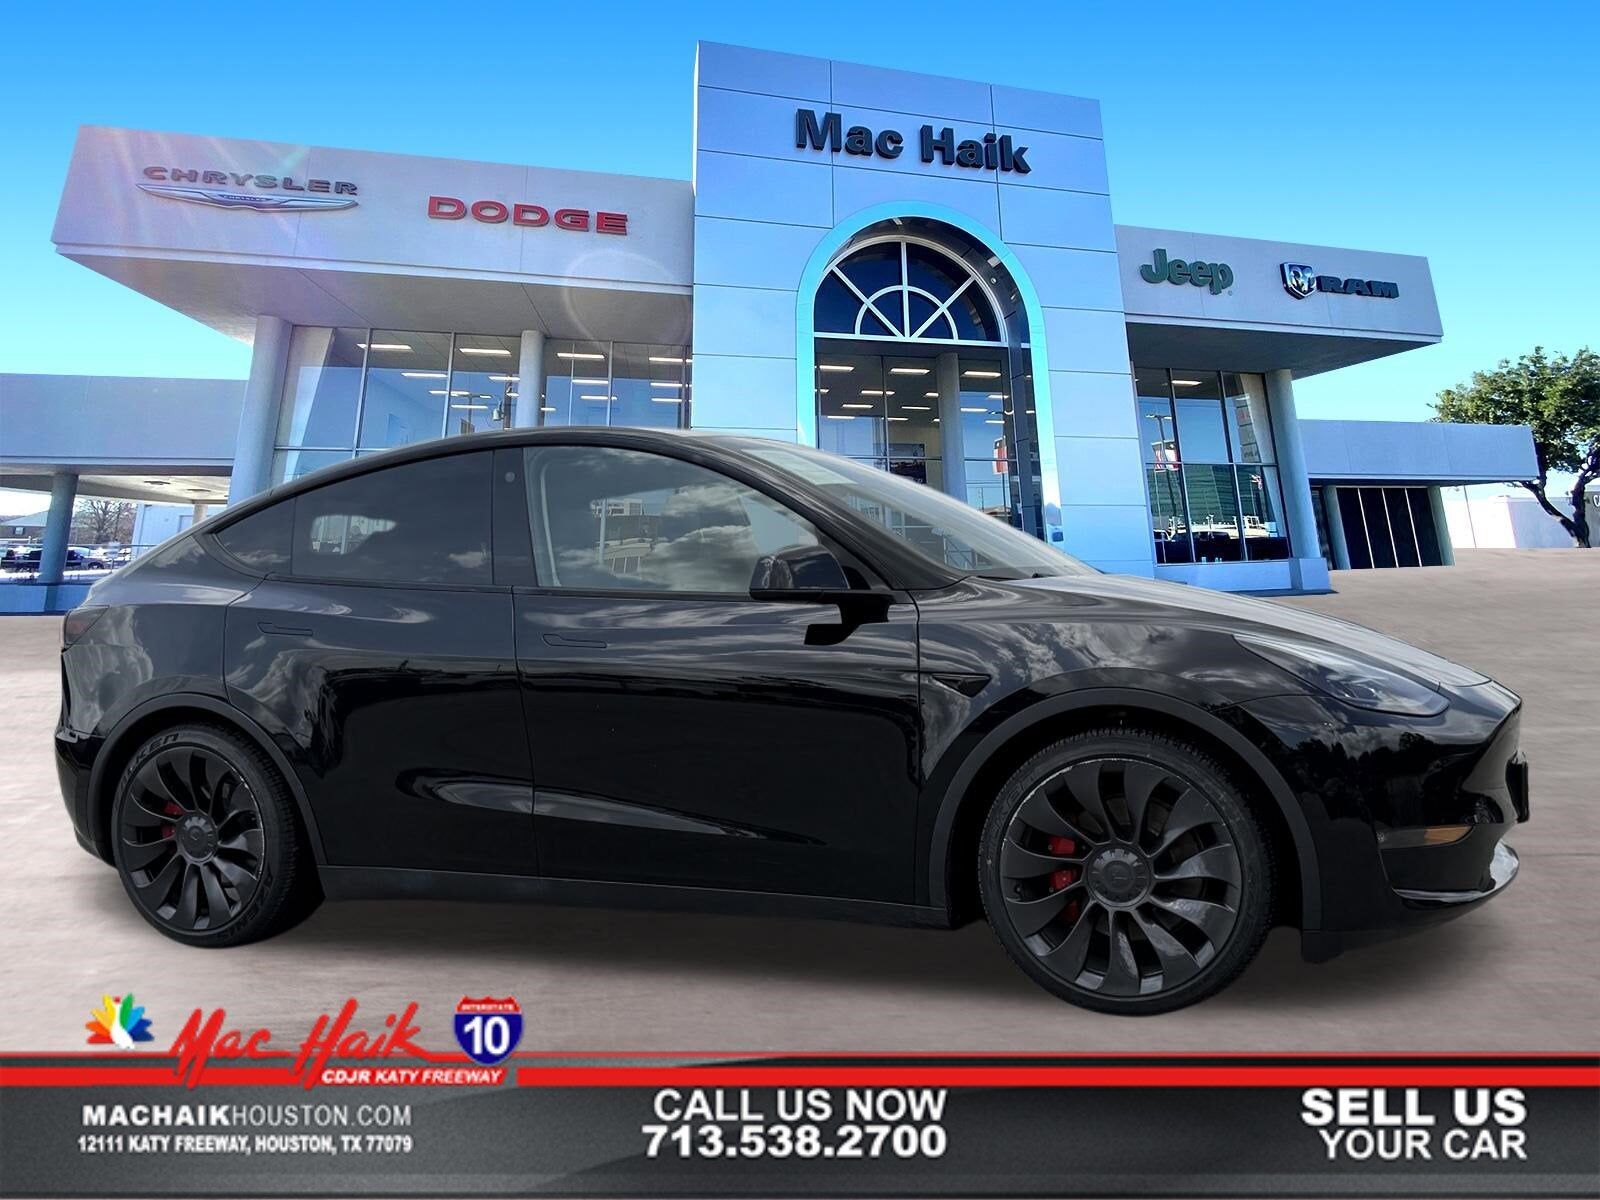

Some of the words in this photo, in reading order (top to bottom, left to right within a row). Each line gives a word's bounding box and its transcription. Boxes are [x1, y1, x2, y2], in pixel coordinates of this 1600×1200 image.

[795, 108, 904, 160] Mac
[920, 124, 1031, 174] Haik
[143, 166, 358, 196] CHRYSLER
[428, 195, 628, 236] DODGE
[1140, 248, 1234, 296] Jeep
[1315, 274, 1400, 299] RAM
